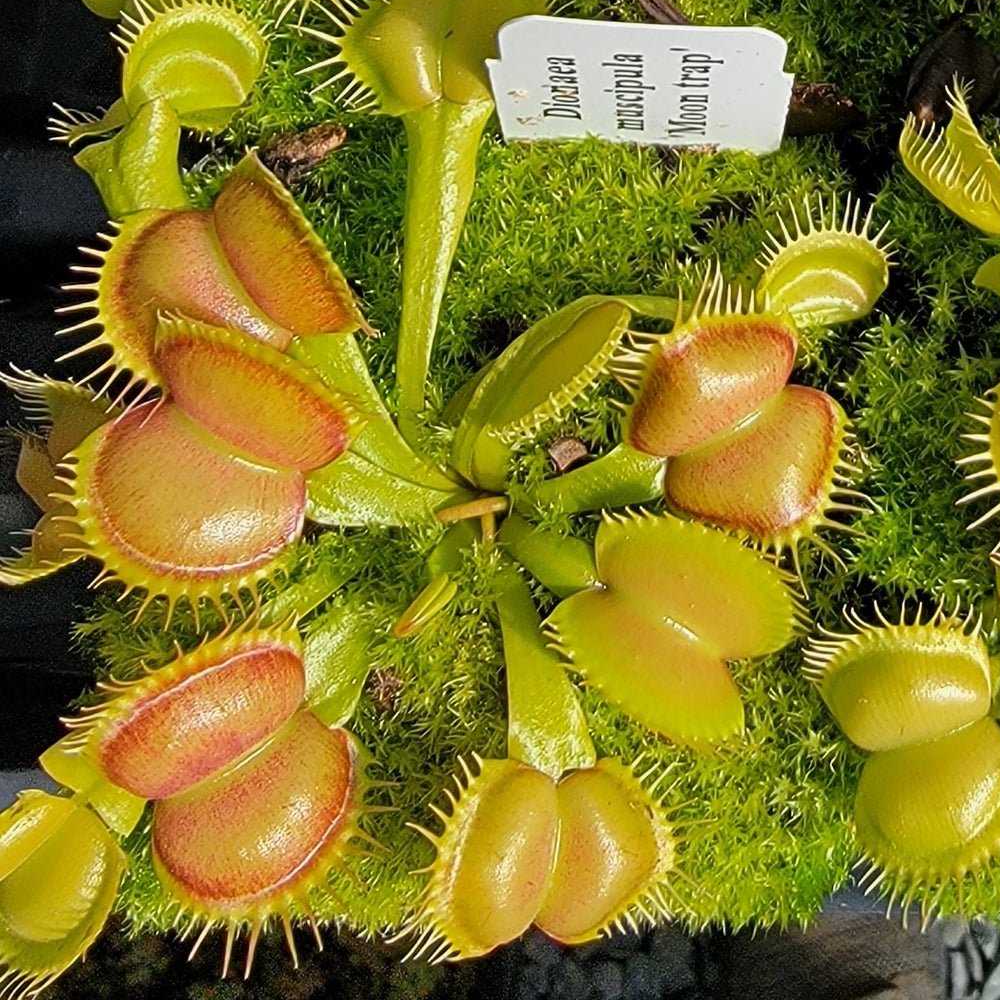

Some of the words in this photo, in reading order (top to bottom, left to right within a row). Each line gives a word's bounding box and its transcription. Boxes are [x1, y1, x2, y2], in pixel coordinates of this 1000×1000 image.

[542, 56, 581, 120] Dionaea
[602, 53, 656, 131] muscipula
[670, 47, 724, 88] trap'
[667, 93, 709, 137] 'Moon
